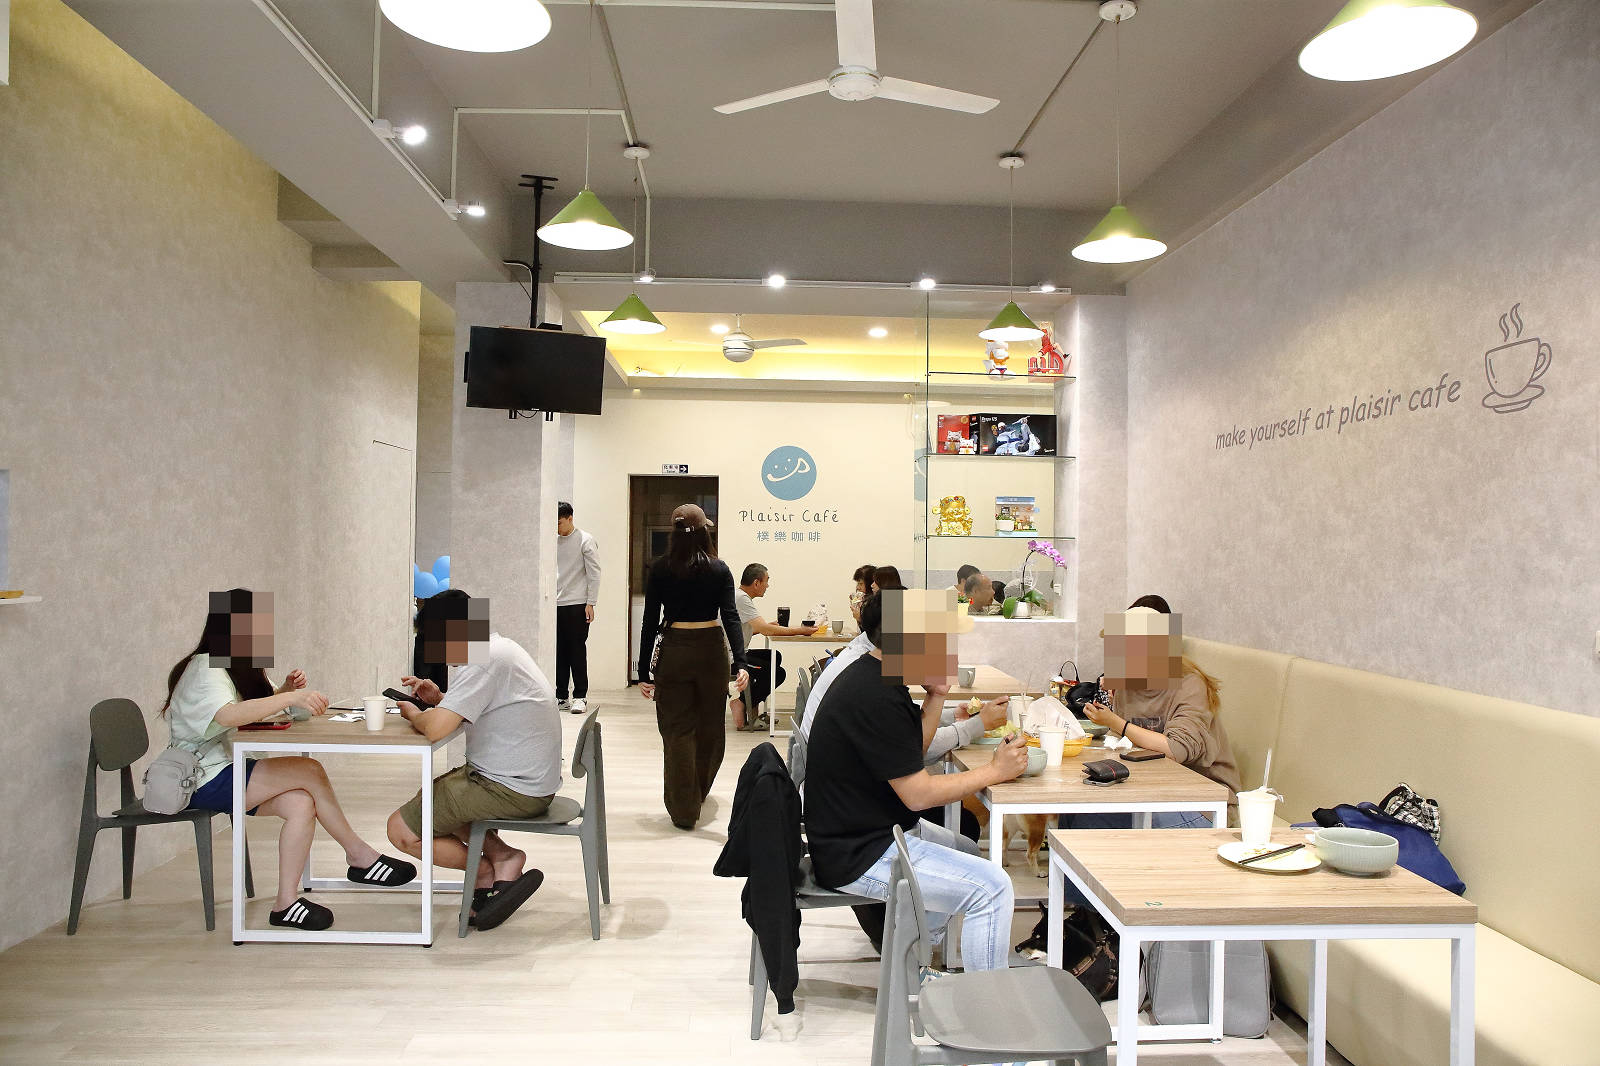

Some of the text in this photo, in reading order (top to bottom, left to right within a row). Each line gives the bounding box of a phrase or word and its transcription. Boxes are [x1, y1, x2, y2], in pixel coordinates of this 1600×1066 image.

[1215, 372, 1462, 450] make yourself at plaisir cafe
[738, 506, 840, 523] Plaisir Café
[756, 530, 822, 543] 樸樂咖啡
